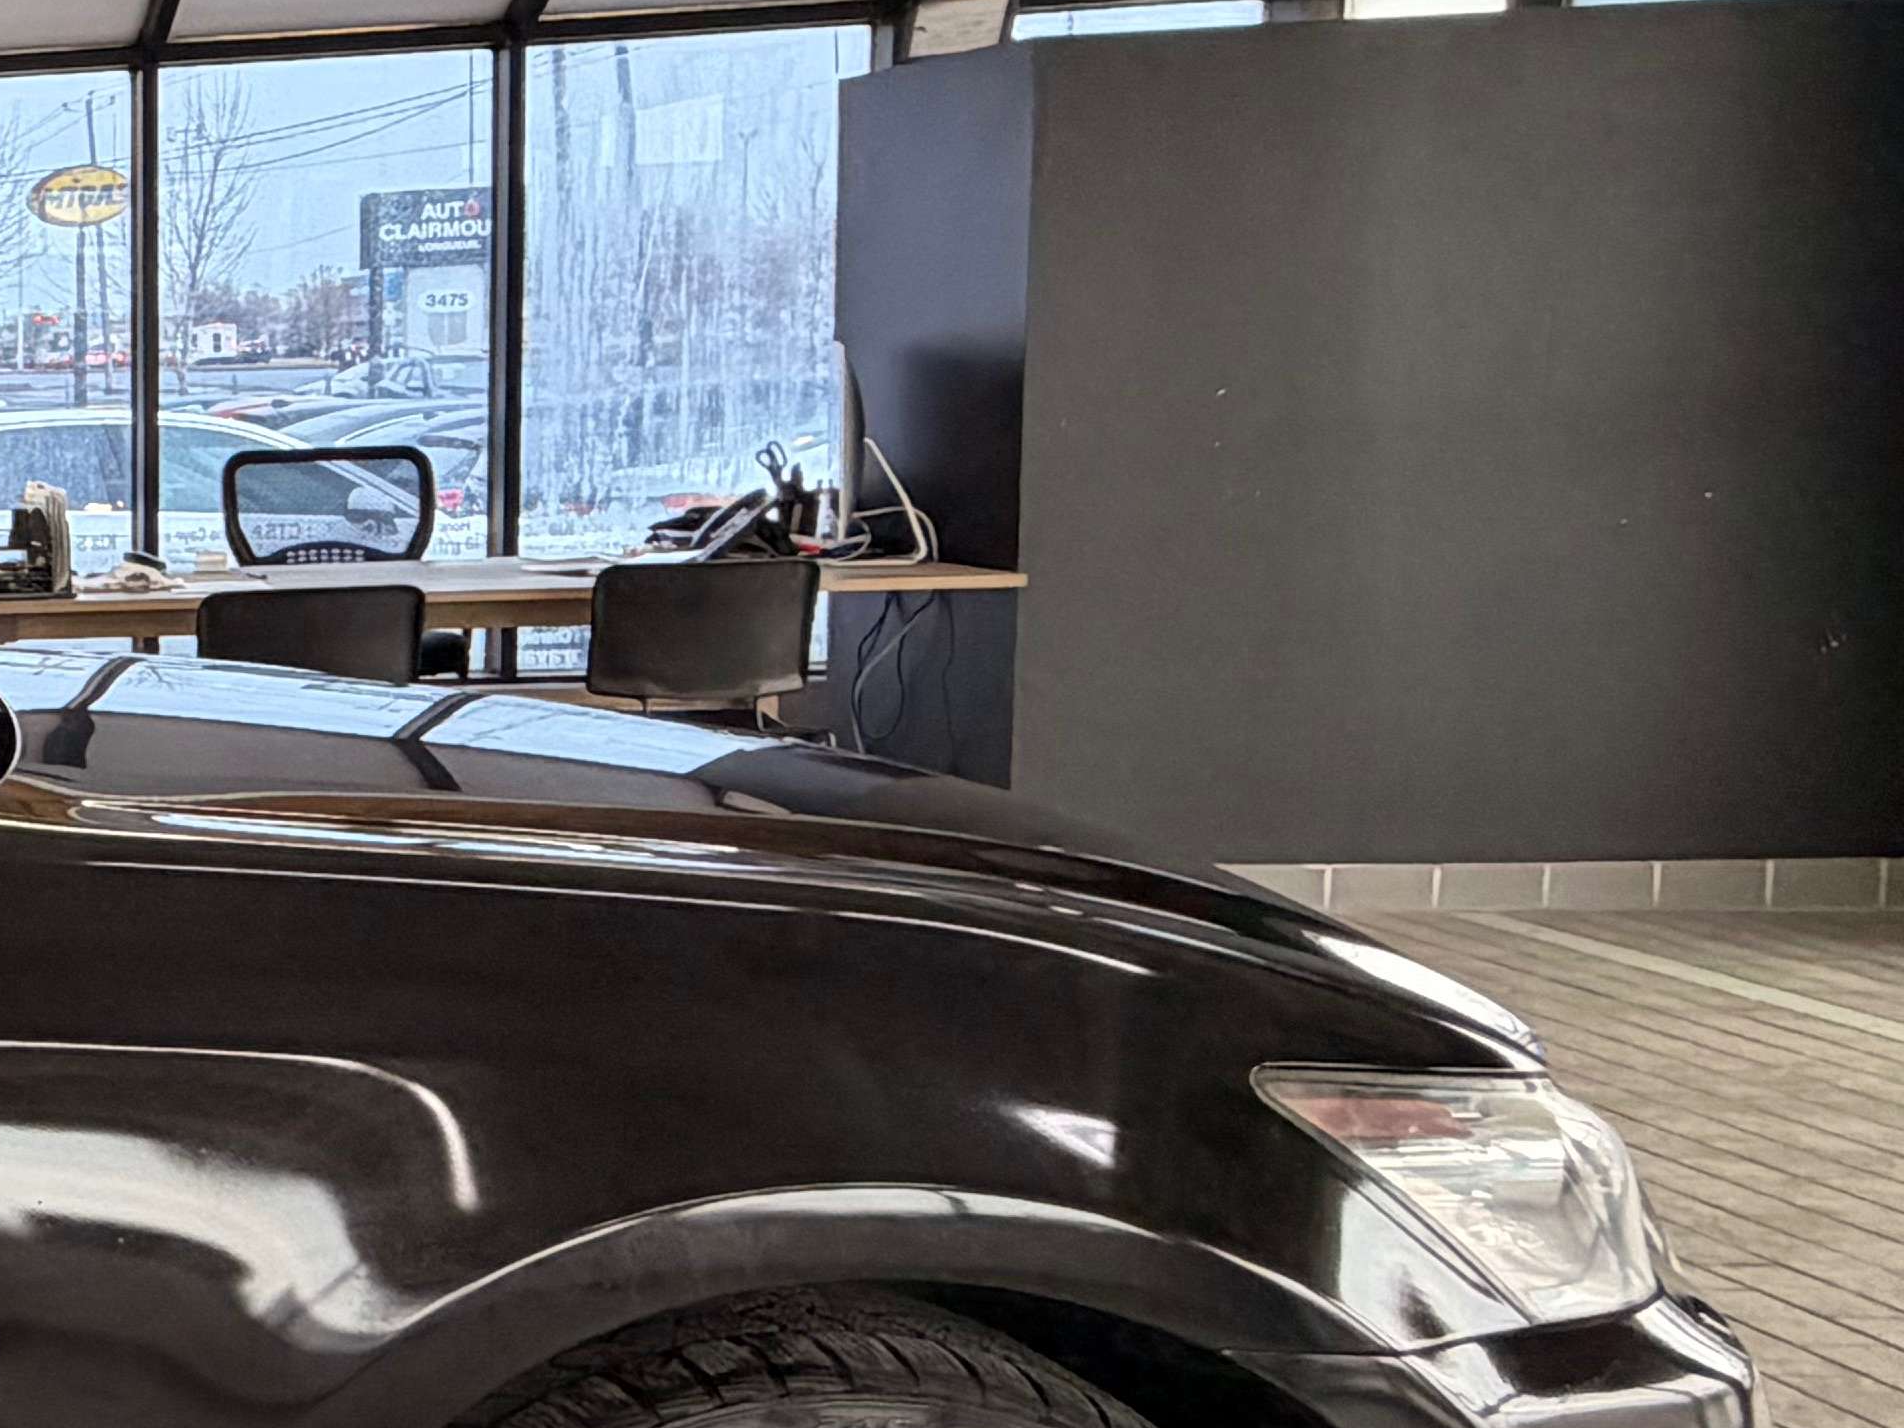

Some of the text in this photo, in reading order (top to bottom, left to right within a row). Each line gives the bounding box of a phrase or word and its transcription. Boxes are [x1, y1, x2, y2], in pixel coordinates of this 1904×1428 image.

[421, 198, 481, 219] AUTO
[379, 219, 492, 241] CLAIRMOU
[425, 293, 469, 308] 3475
